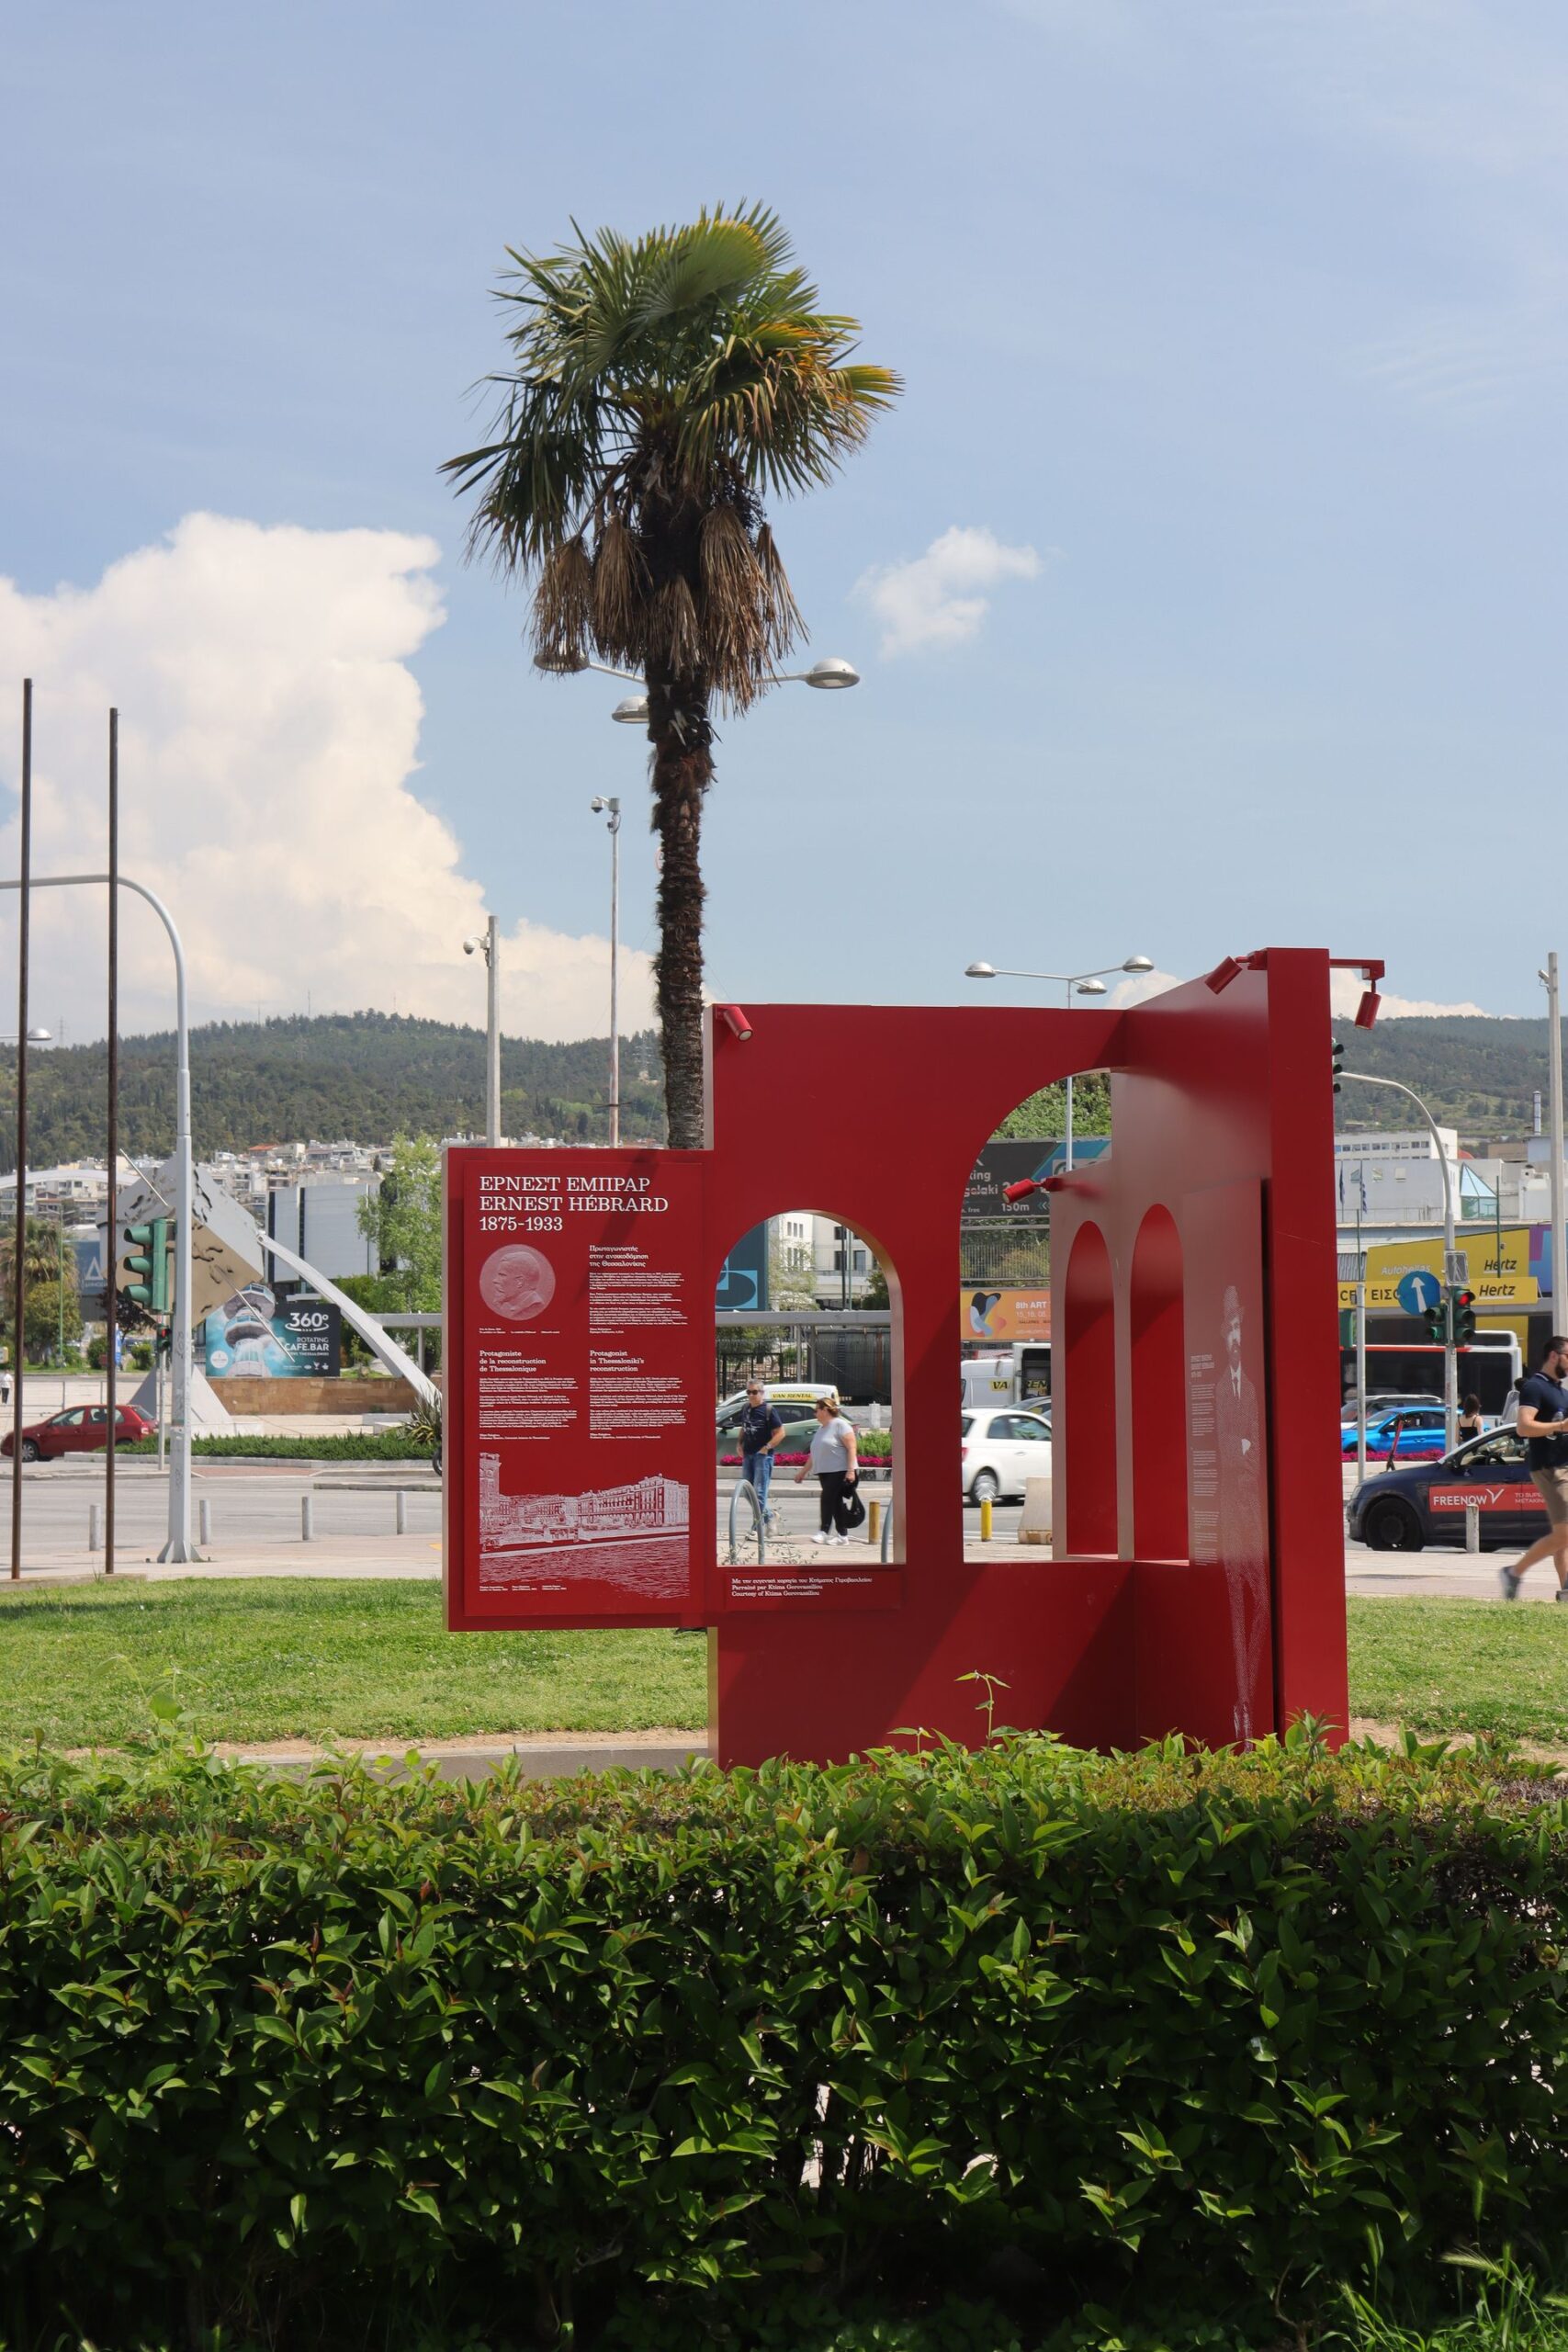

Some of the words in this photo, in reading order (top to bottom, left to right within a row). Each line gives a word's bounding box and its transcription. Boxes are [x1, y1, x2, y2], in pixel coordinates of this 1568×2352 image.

[479, 1176, 560, 1192] ΕΡΝΕΣΤ
[566, 1177, 650, 1193] ΕΜΠΡΑΡ
[479, 1196, 563, 1211] ERNEST
[568, 1194, 669, 1212] HÉBRARD
[479, 1216, 563, 1231] 1875-1933
[1484, 1259, 1517, 1272] Hertz
[1479, 1284, 1516, 1296] Hertz
[1015, 1301, 1029, 1309] 8th
[1030, 1301, 1047, 1309] ART
[285, 1343, 330, 1351] CAFE.BAR
[479, 1350, 522, 1358] Protagoniste
[590, 1350, 628, 1358] Protagonist
[1433, 1495, 1487, 1506] FREENOW
